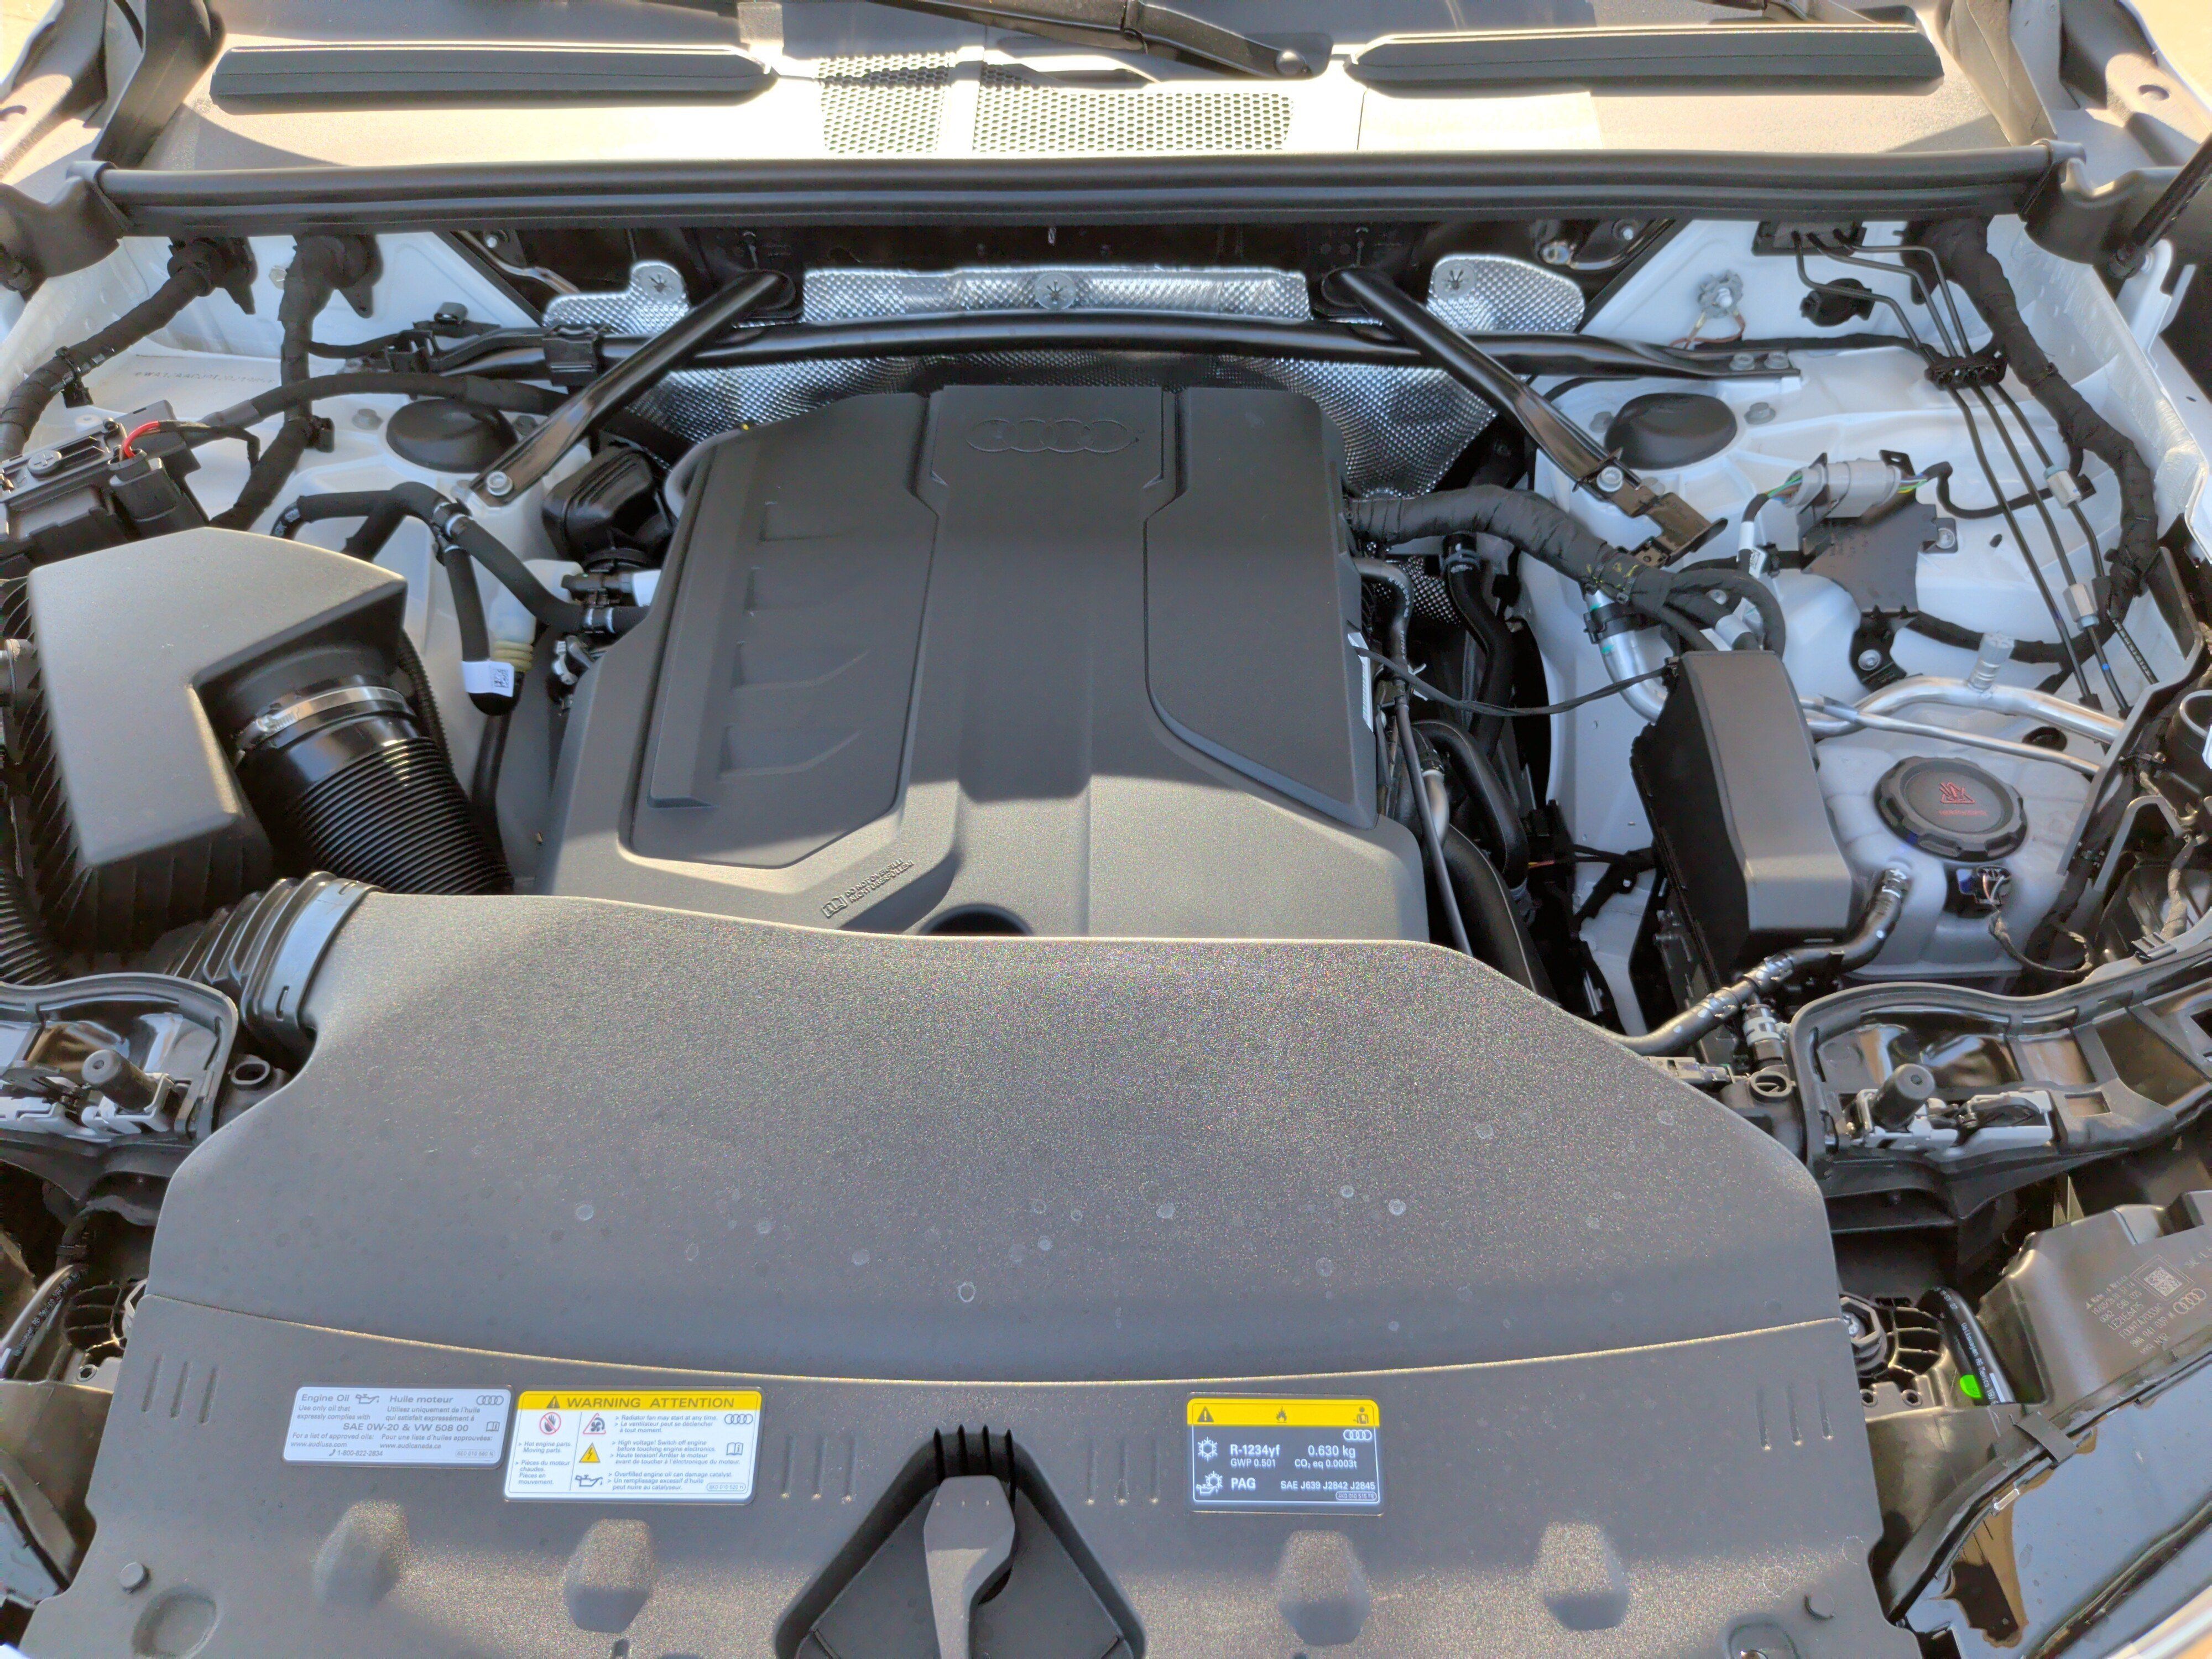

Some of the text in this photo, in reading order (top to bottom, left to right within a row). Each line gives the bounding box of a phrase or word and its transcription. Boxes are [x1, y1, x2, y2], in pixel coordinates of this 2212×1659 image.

[301, 1394, 333, 1402] Engine
[567, 1397, 734, 1408] WARNING ATTENTION
[1230, 1444, 1355, 1458] R-1234yf 0.630 kg
[1230, 1458, 1251, 1467] GWP
[1254, 1458, 1276, 1467] 0.501
[1313, 1461, 1324, 1469] eq
[1231, 1477, 1375, 1490] PAG SAE J639 J2842 J2845
